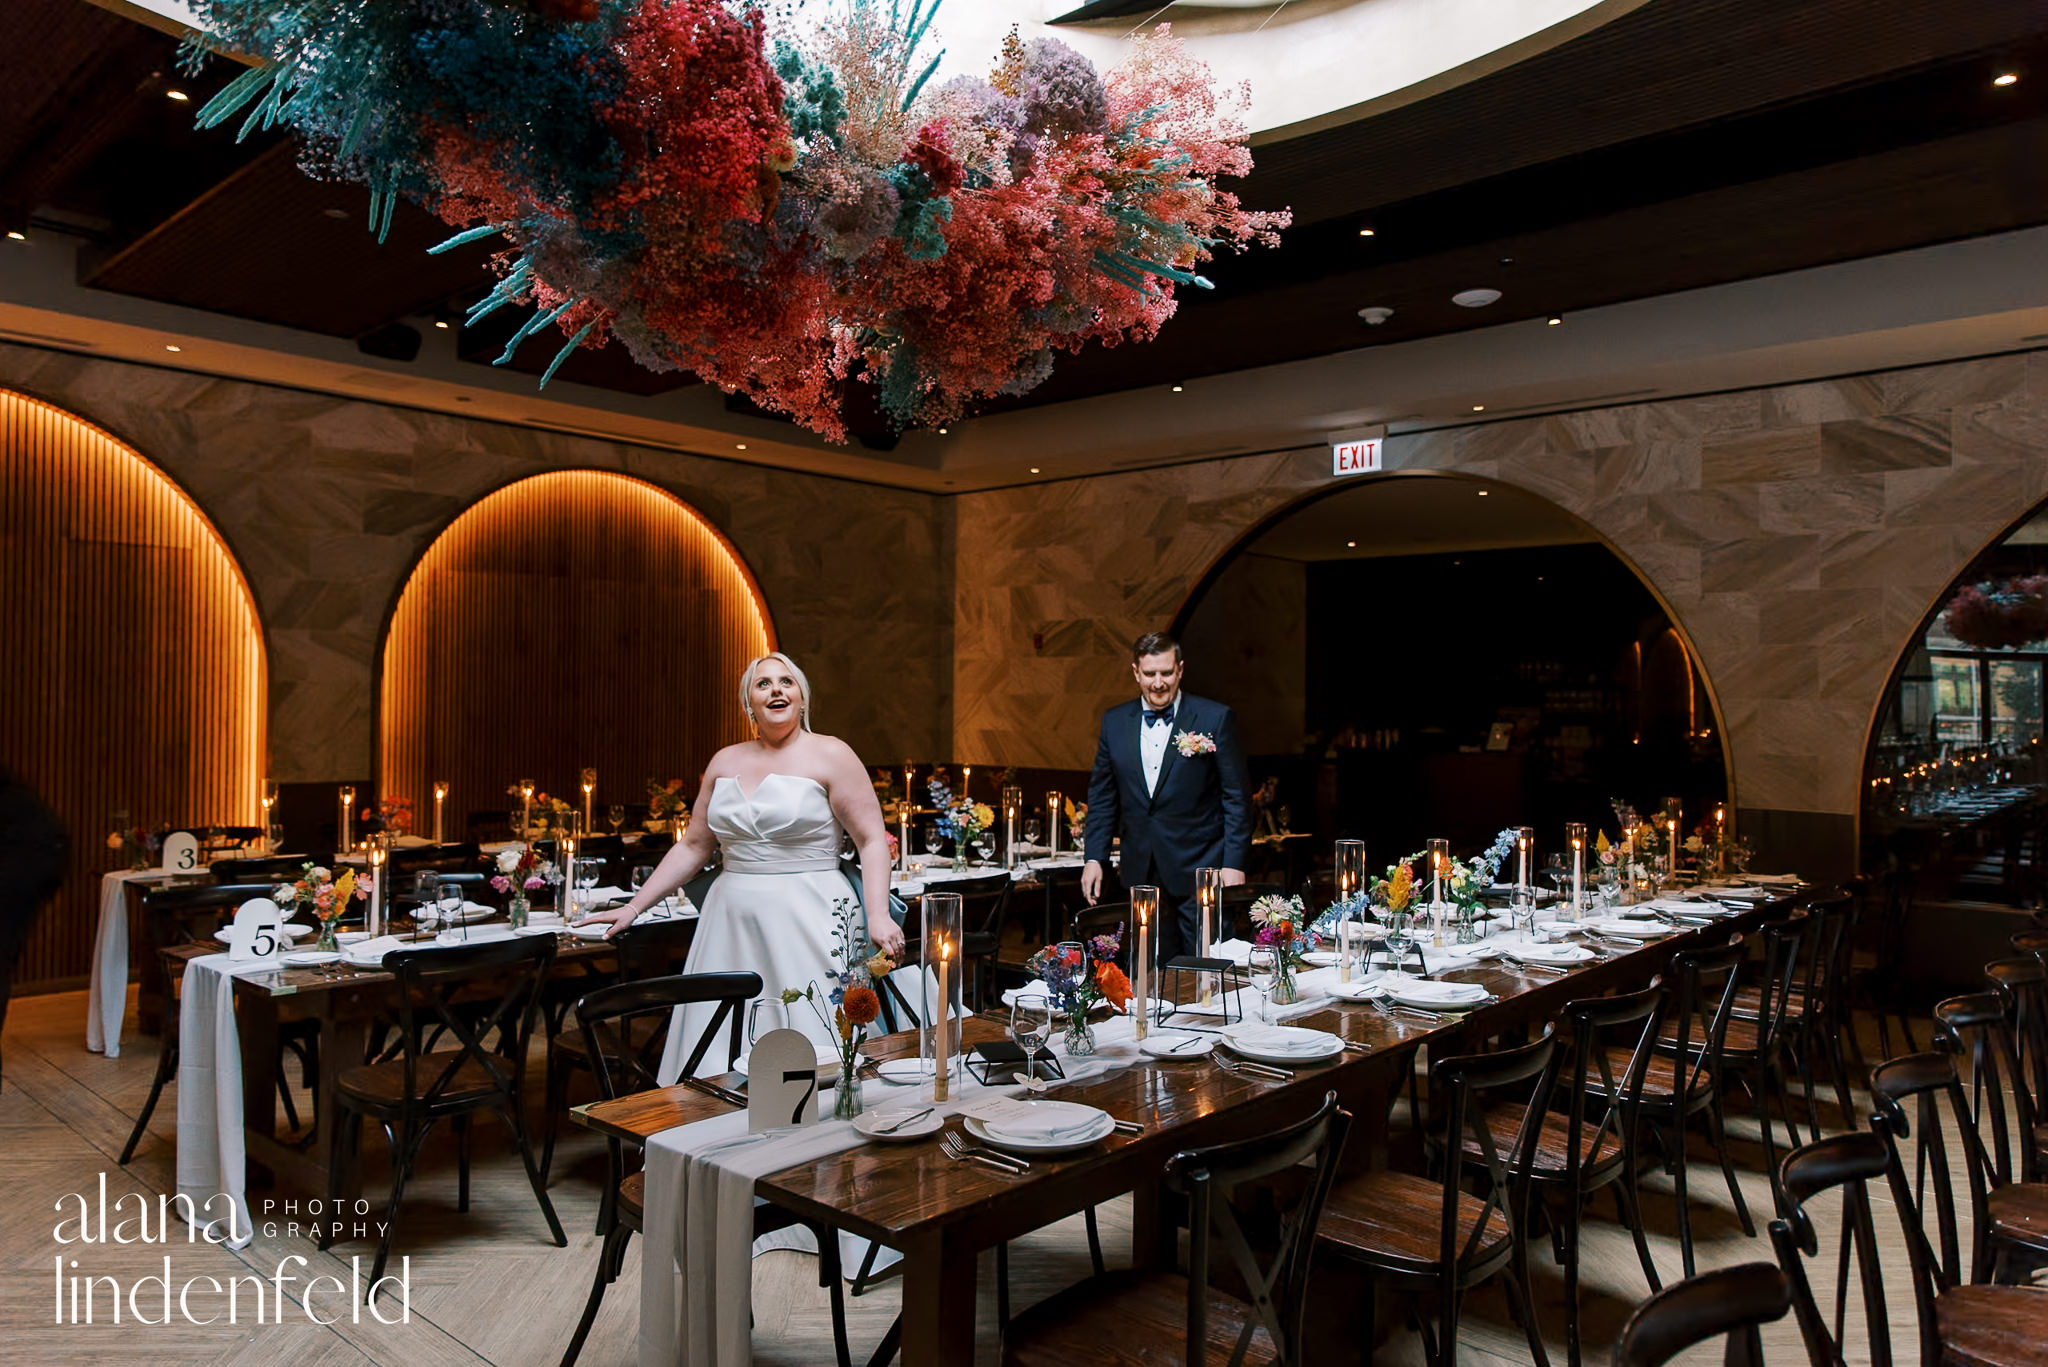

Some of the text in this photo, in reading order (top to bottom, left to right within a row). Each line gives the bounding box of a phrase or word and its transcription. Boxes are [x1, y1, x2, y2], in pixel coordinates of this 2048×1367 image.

[1340, 443, 1375, 470] EXIT
[178, 848, 195, 869] 3
[251, 924, 275, 956] 5
[783, 1070, 815, 1124] 7
